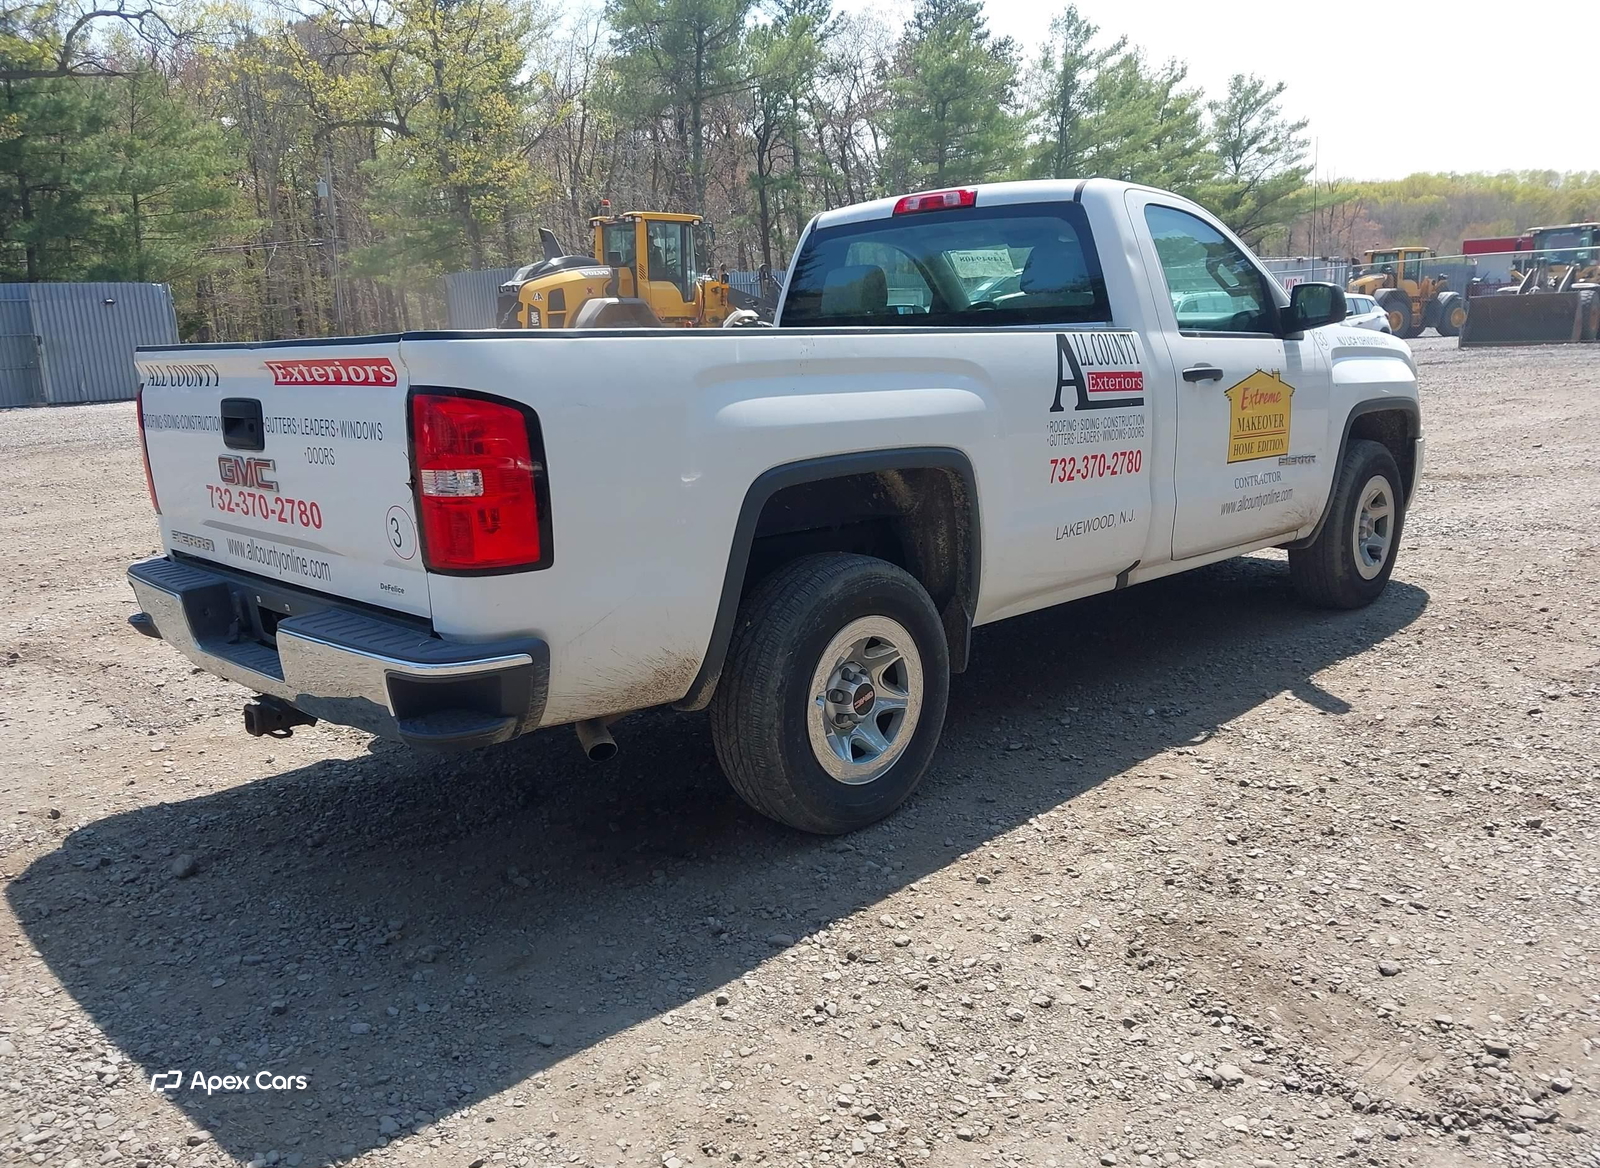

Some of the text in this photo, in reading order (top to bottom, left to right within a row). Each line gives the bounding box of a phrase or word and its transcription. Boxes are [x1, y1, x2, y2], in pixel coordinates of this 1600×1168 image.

[1091, 333, 1140, 366] COUNTY
[145, 364, 219, 387] ALL COUNTY
[269, 362, 397, 384] Exteriors
[1088, 374, 1143, 390] Exteriors
[1241, 387, 1283, 411] Extreme
[1237, 413, 1284, 433] MAKEOVER
[1233, 438, 1284, 456] HOME EDITION
[218, 453, 280, 493] GMC
[1050, 449, 1142, 484] 732-370-2780
[1234, 470, 1282, 490] CONTRACTOR
[205, 484, 323, 530] 732-370-2780
[1055, 509, 1136, 541] LAKEWOOD, N.J.
[171, 529, 215, 552] SIERRA
[226, 536, 332, 582] www.allcountyonline.com
[380, 582, 405, 595] DeFelice
